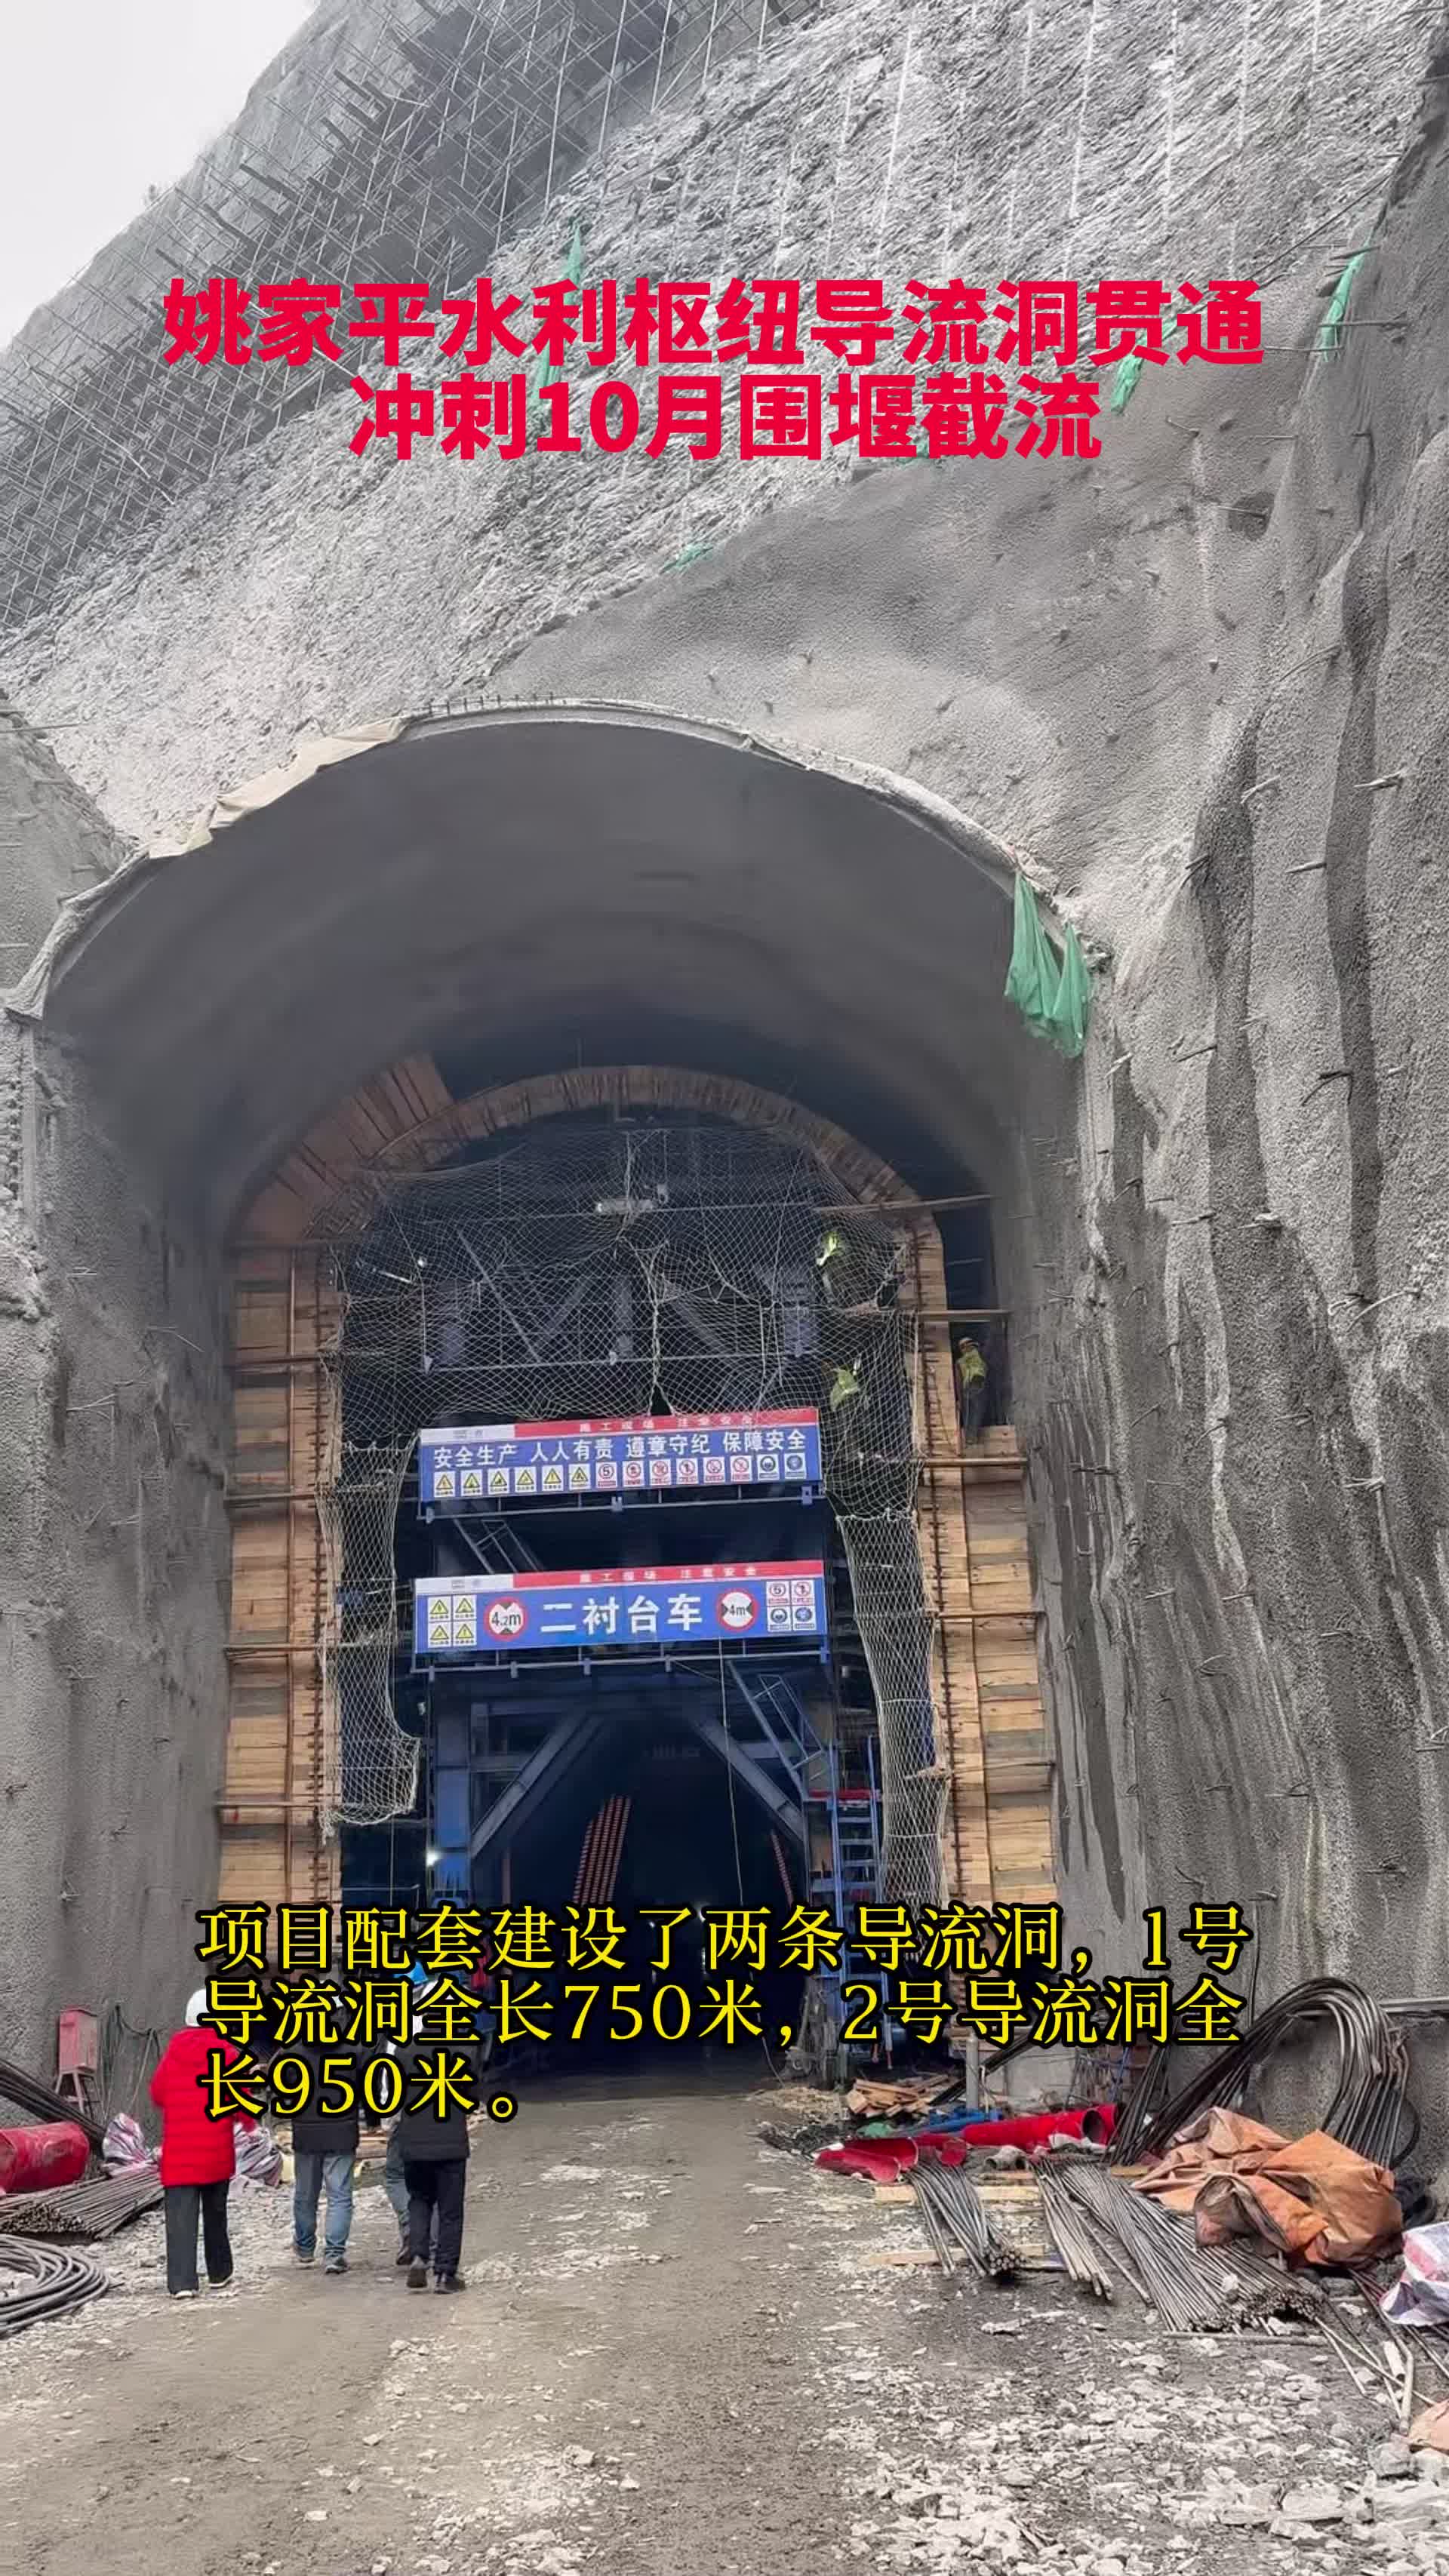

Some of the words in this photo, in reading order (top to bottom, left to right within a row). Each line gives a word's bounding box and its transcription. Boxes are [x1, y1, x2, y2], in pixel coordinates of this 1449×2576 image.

[434, 1443, 517, 1468] 安全生产
[531, 1438, 613, 1462] 人人有责
[626, 1433, 711, 1458] 遵章守纪
[722, 1428, 806, 1452] 保障安全
[491, 1612, 521, 1627] 4.2m
[540, 1593, 703, 1635] 二衬台车
[729, 1605, 746, 1616] 4m
